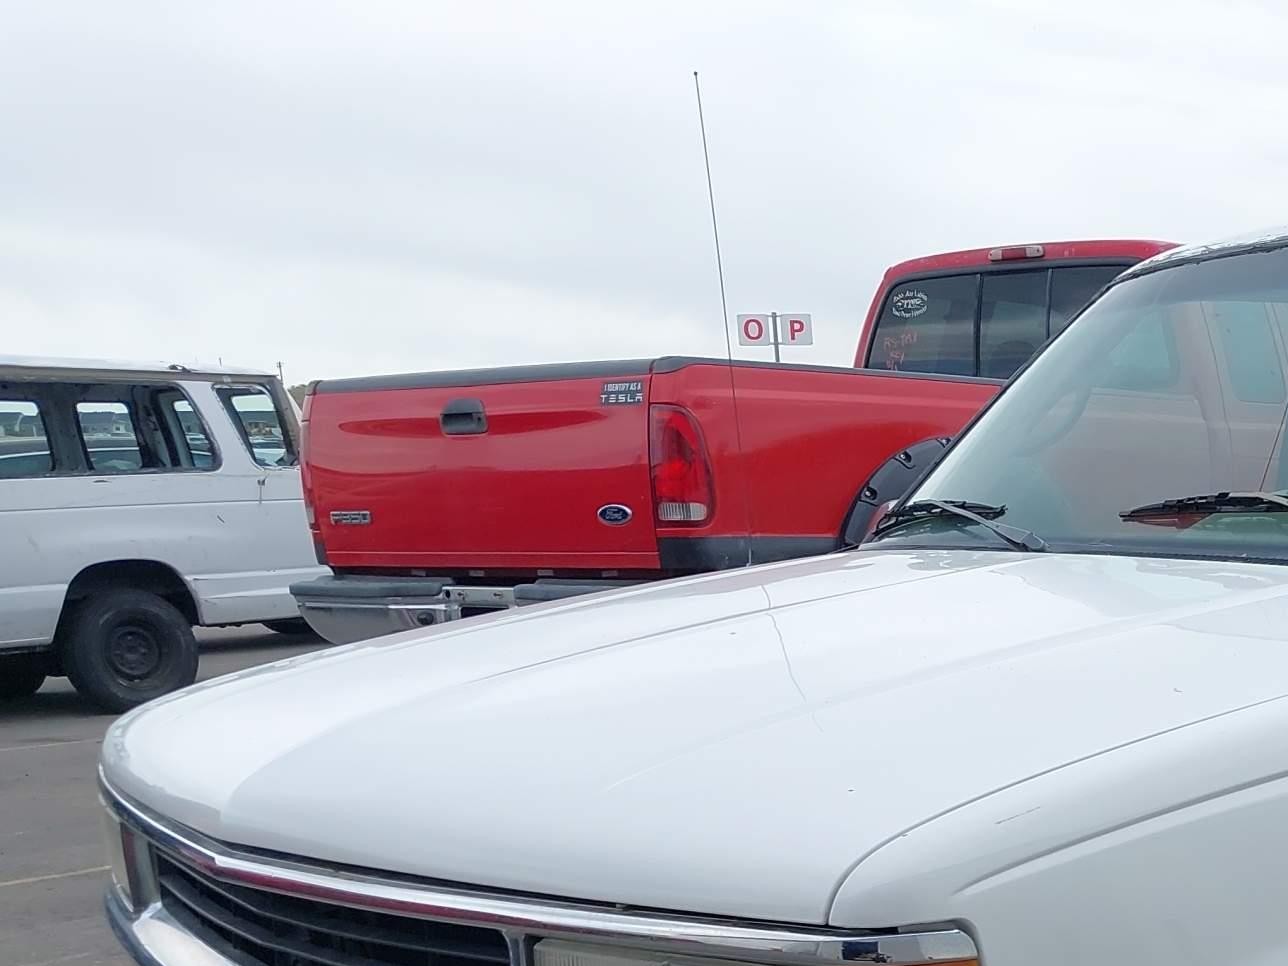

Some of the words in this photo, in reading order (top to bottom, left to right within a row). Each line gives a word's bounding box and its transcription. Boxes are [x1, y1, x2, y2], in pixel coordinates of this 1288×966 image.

[743, 318, 764, 341] O
[788, 319, 805, 341] P
[607, 383, 629, 392] IDENTIFY
[600, 393, 643, 404] TESLA
